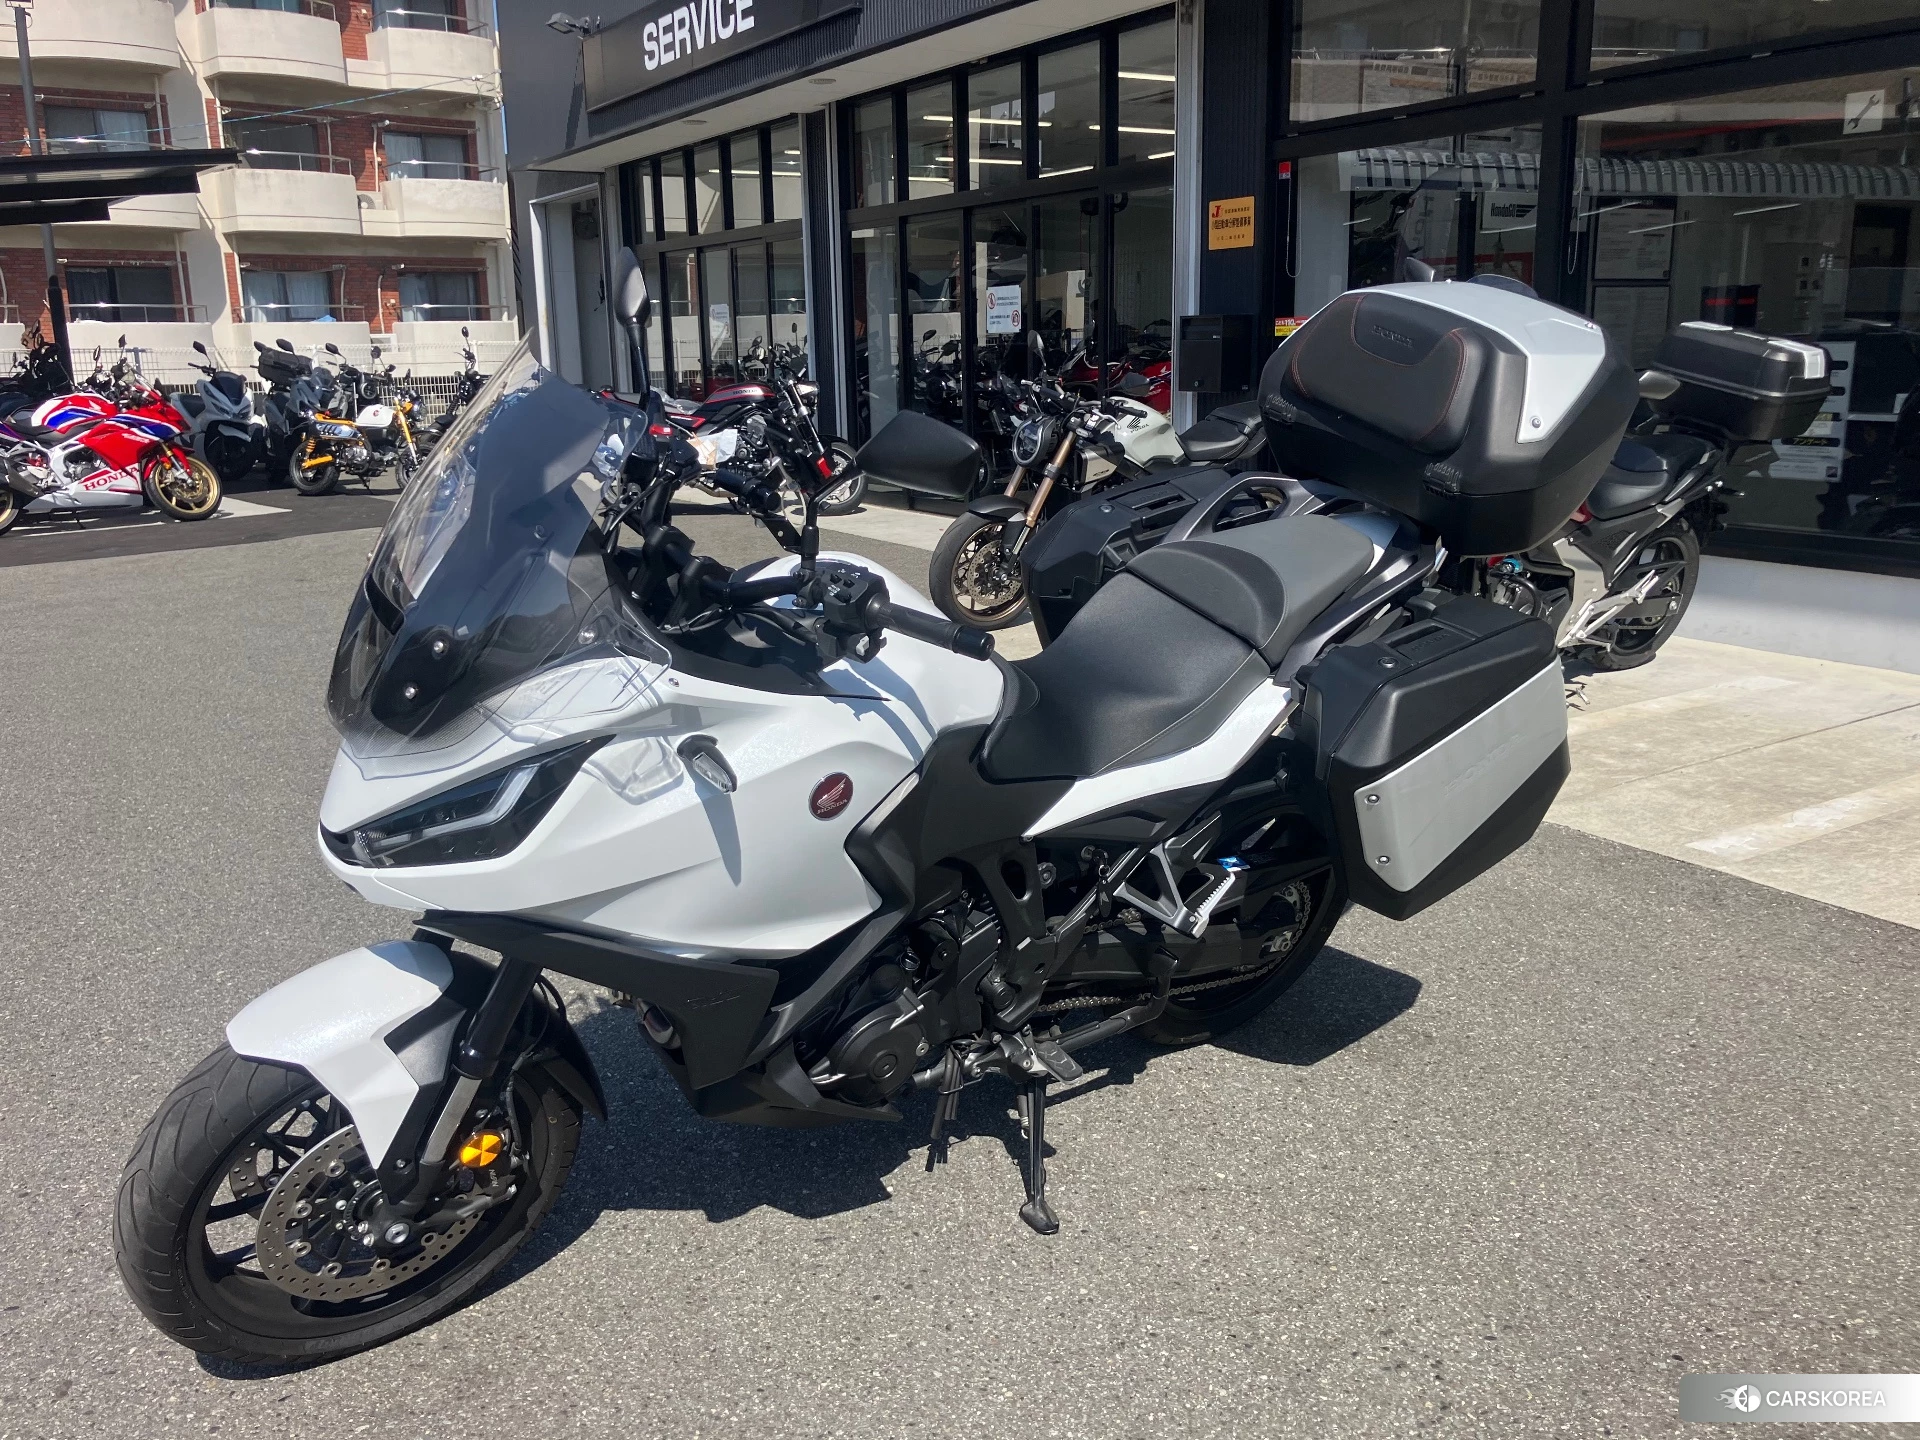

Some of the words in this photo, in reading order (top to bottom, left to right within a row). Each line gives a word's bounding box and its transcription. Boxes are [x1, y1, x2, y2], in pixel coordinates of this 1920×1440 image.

[643, 0, 755, 70] SERVICE
[84, 466, 140, 490] HONDA
[816, 799, 848, 814] HONDA
